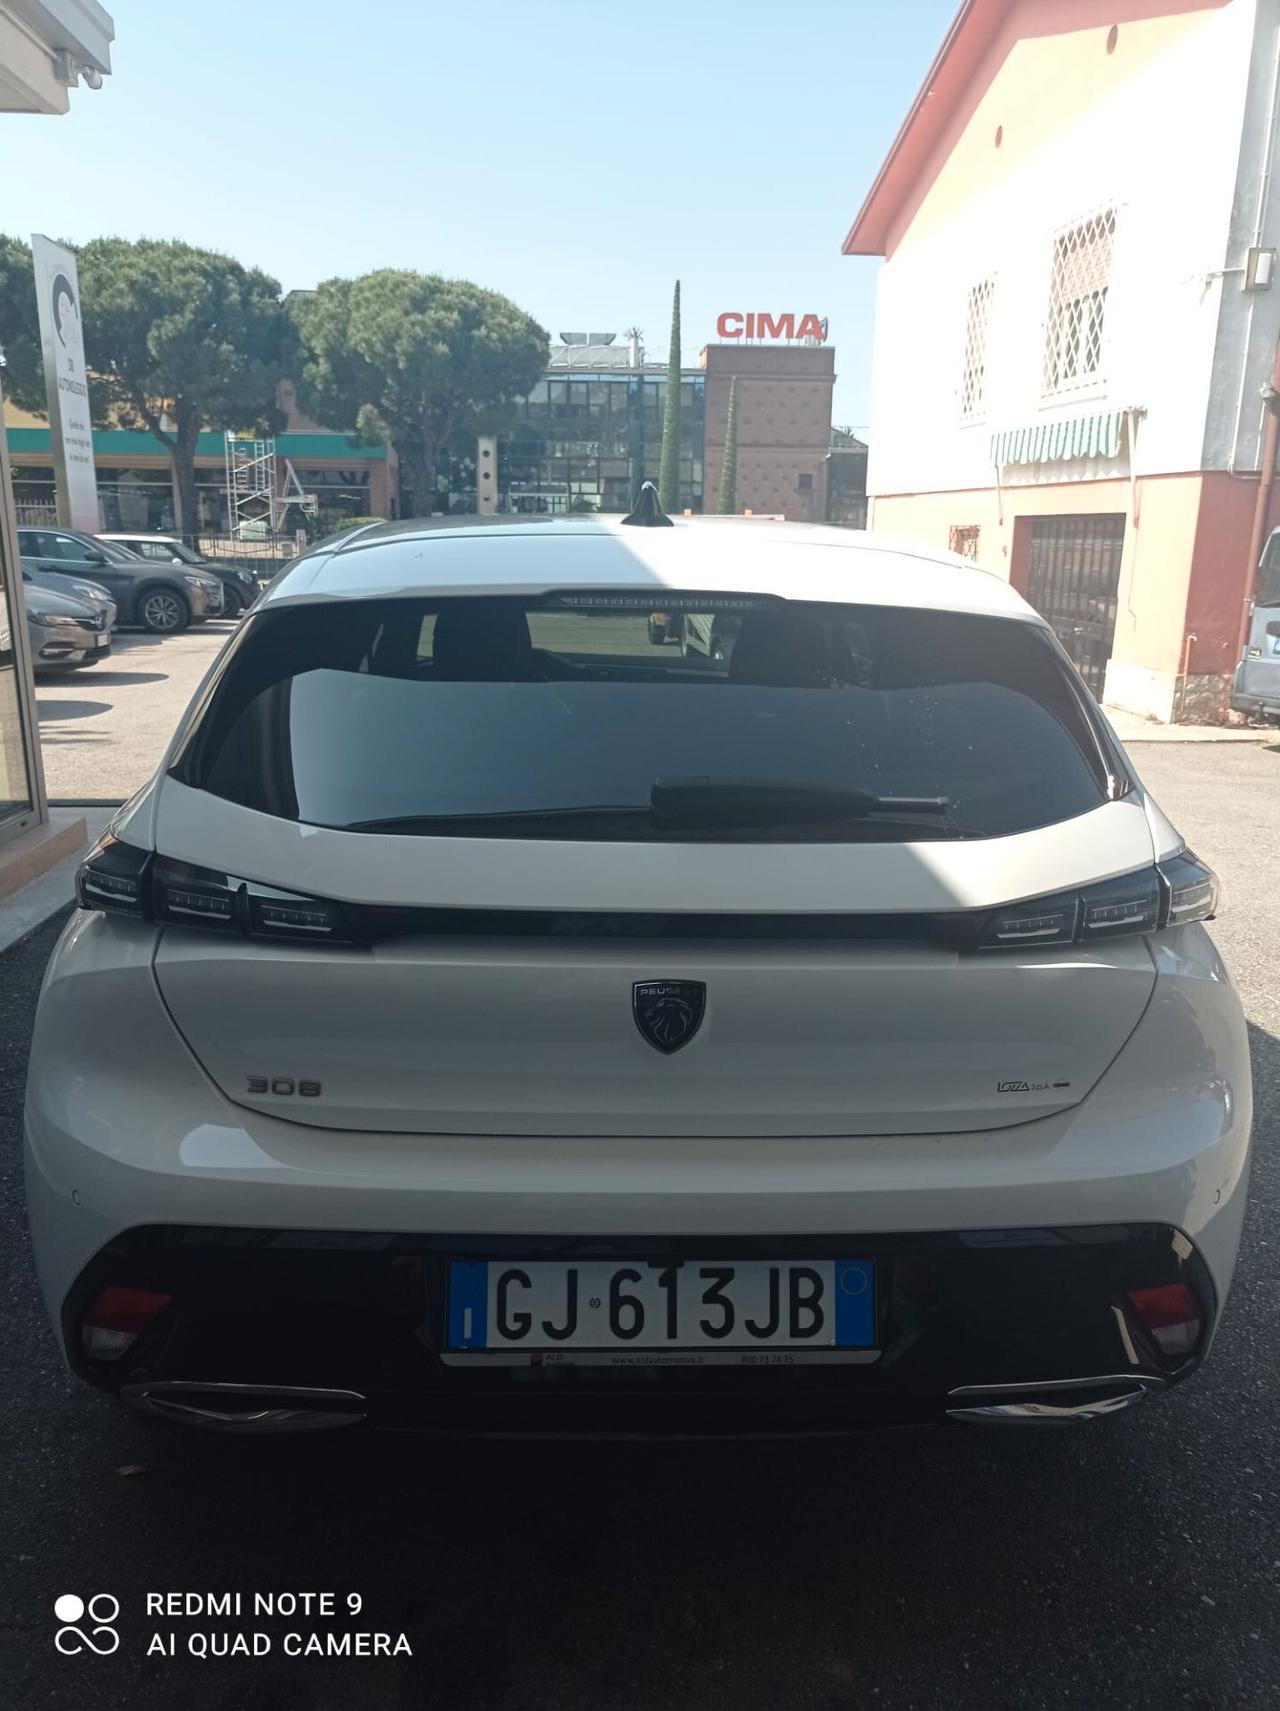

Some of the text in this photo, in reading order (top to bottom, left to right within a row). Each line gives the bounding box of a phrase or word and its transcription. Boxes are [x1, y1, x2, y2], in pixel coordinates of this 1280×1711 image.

[717, 312, 824, 340] CIMA
[247, 1075, 321, 1097] 308
[497, 1268, 578, 1340] GJ
